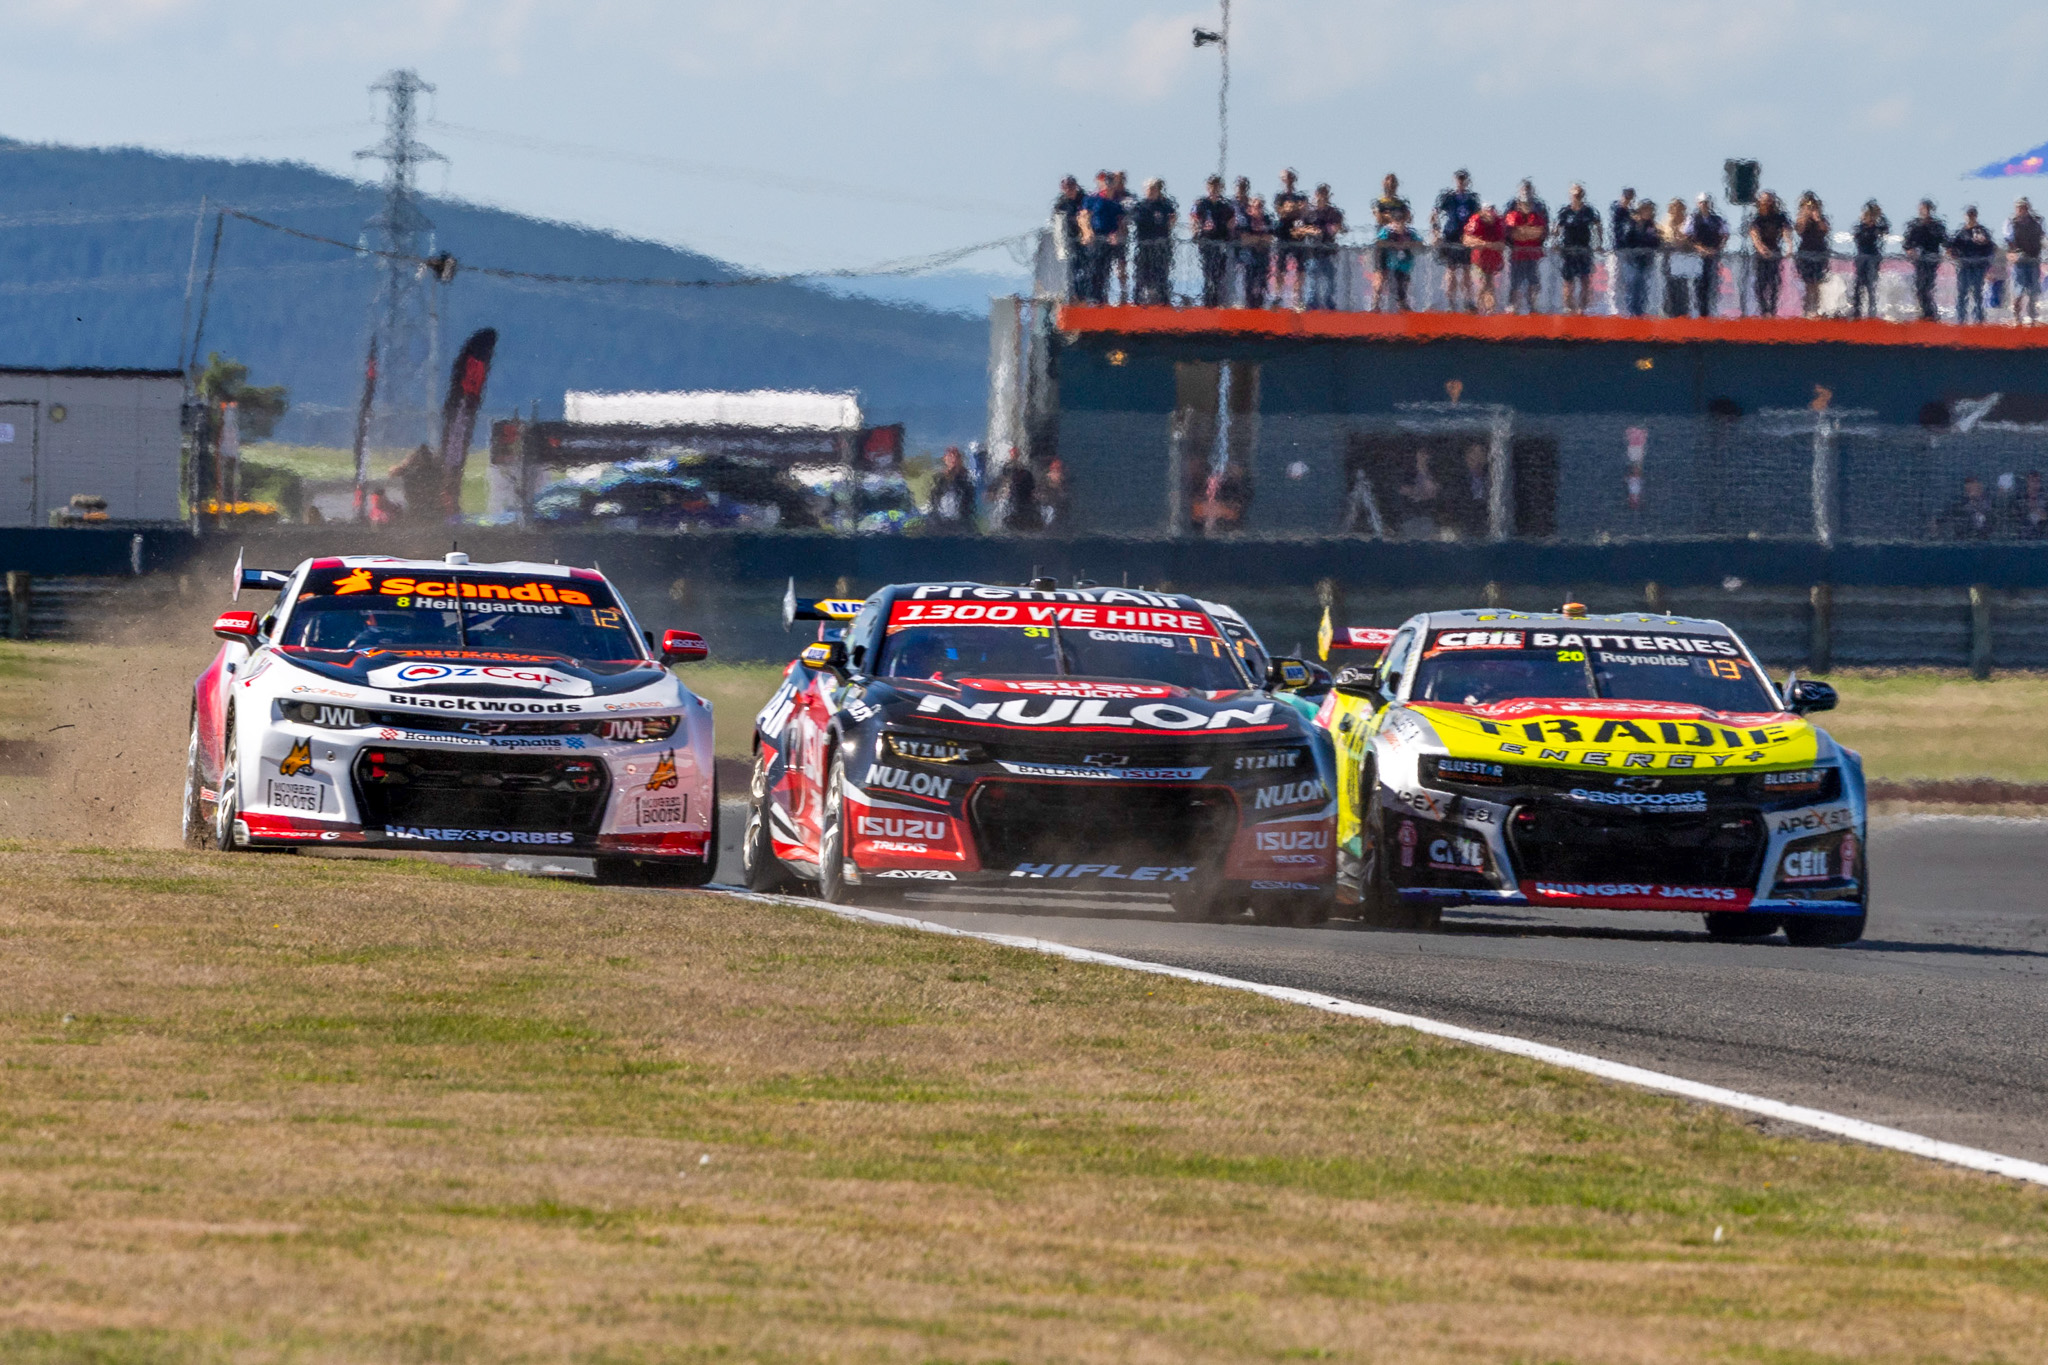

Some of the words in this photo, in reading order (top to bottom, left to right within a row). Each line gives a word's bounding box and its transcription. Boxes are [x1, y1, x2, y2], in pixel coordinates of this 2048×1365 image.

[379, 577, 593, 605] Scandia
[397, 597, 411, 608] 8
[415, 597, 563, 615] Heimgartner
[590, 609, 620, 629] 12
[898, 605, 1018, 621] 1300
[1028, 607, 1098, 623] WE
[1107, 610, 1206, 631] HIRE
[1023, 627, 1050, 638] 31
[1088, 630, 1175, 648] Golding
[1532, 633, 1738, 656] BATTERIES
[1557, 650, 1585, 662] 20
[1600, 651, 1690, 667] Reynolds
[1707, 659, 1742, 680] 13
[1004, 681, 1164, 695] ISUZU
[389, 694, 583, 713] Blackwoods
[916, 694, 1274, 729] NULON
[314, 706, 361, 727] JWL
[603, 720, 649, 740] JWL
[1461, 715, 1790, 748] TRADIE
[405, 732, 483, 745] Hamilton
[489, 736, 562, 750] Asphalts
[898, 741, 970, 761] SYZMIK
[1234, 753, 1299, 770] SYZMIK
[865, 764, 953, 799] NULON
[1019, 766, 1109, 777] BALLARAT
[1122, 770, 1192, 779] ISUZU
[274, 792, 316, 811] BOOTS
[1254, 779, 1325, 809] NULON
[1570, 788, 1708, 805] eastcoast
[641, 808, 682, 824] BOOTS
[857, 816, 945, 839] ISUZU
[1256, 831, 1329, 851] ISUZU
[1009, 862, 1198, 882] HIFLEX
[1535, 882, 1654, 896] HUNGRY
